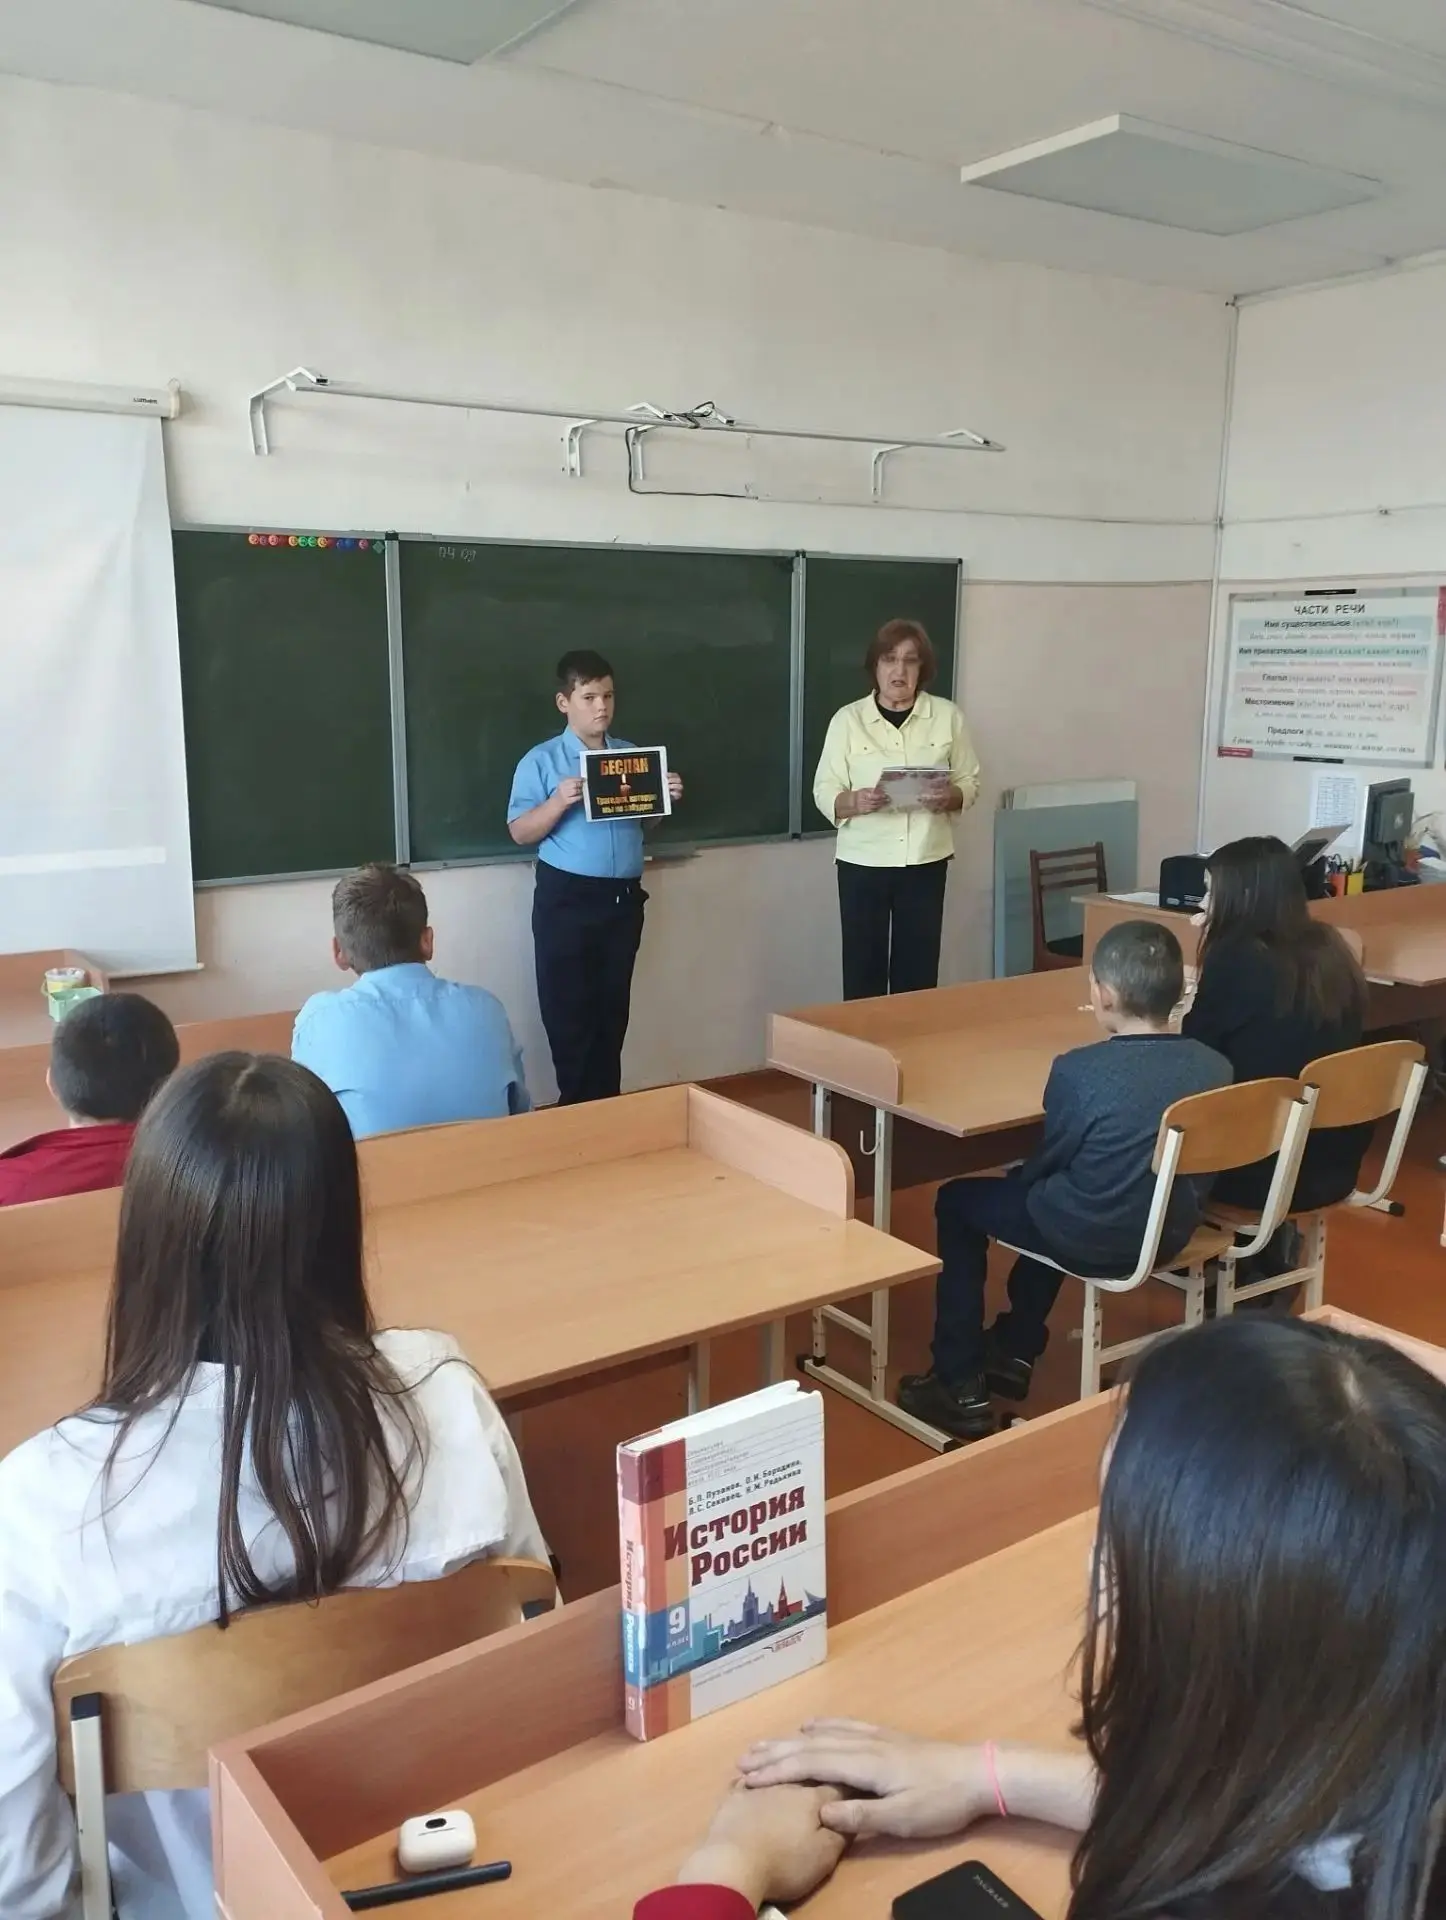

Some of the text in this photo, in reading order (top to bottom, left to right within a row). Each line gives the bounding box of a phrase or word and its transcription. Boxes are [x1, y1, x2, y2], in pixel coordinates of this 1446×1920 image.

[1281, 620, 1350, 629] существительное
[1294, 604, 1366, 615] ЧАСТИ РЕЧИ
[663, 1485, 805, 1562] История
[624, 1539, 634, 1610] История
[691, 1519, 807, 1587] России
[669, 1606, 686, 1635] 9
